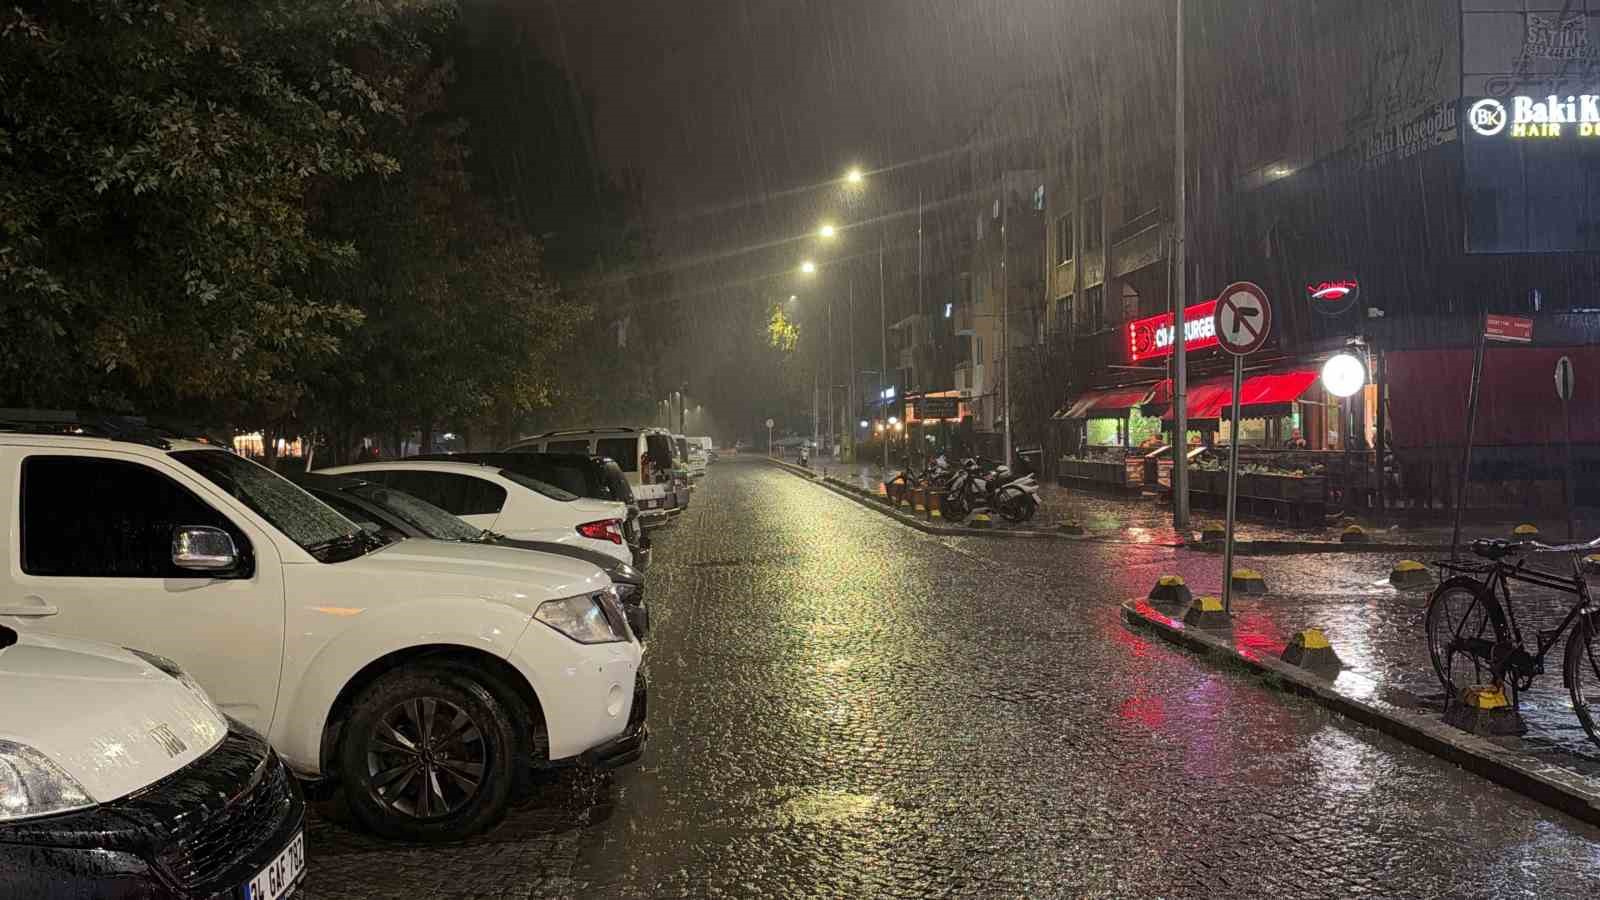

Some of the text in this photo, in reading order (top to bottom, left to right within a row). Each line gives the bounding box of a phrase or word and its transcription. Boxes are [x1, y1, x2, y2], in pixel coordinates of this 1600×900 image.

[1478, 108, 1498, 126] BK
[1513, 95, 1576, 123] Baki
[1512, 123, 1560, 137] HAIR
[268, 855, 286, 898] GAF
